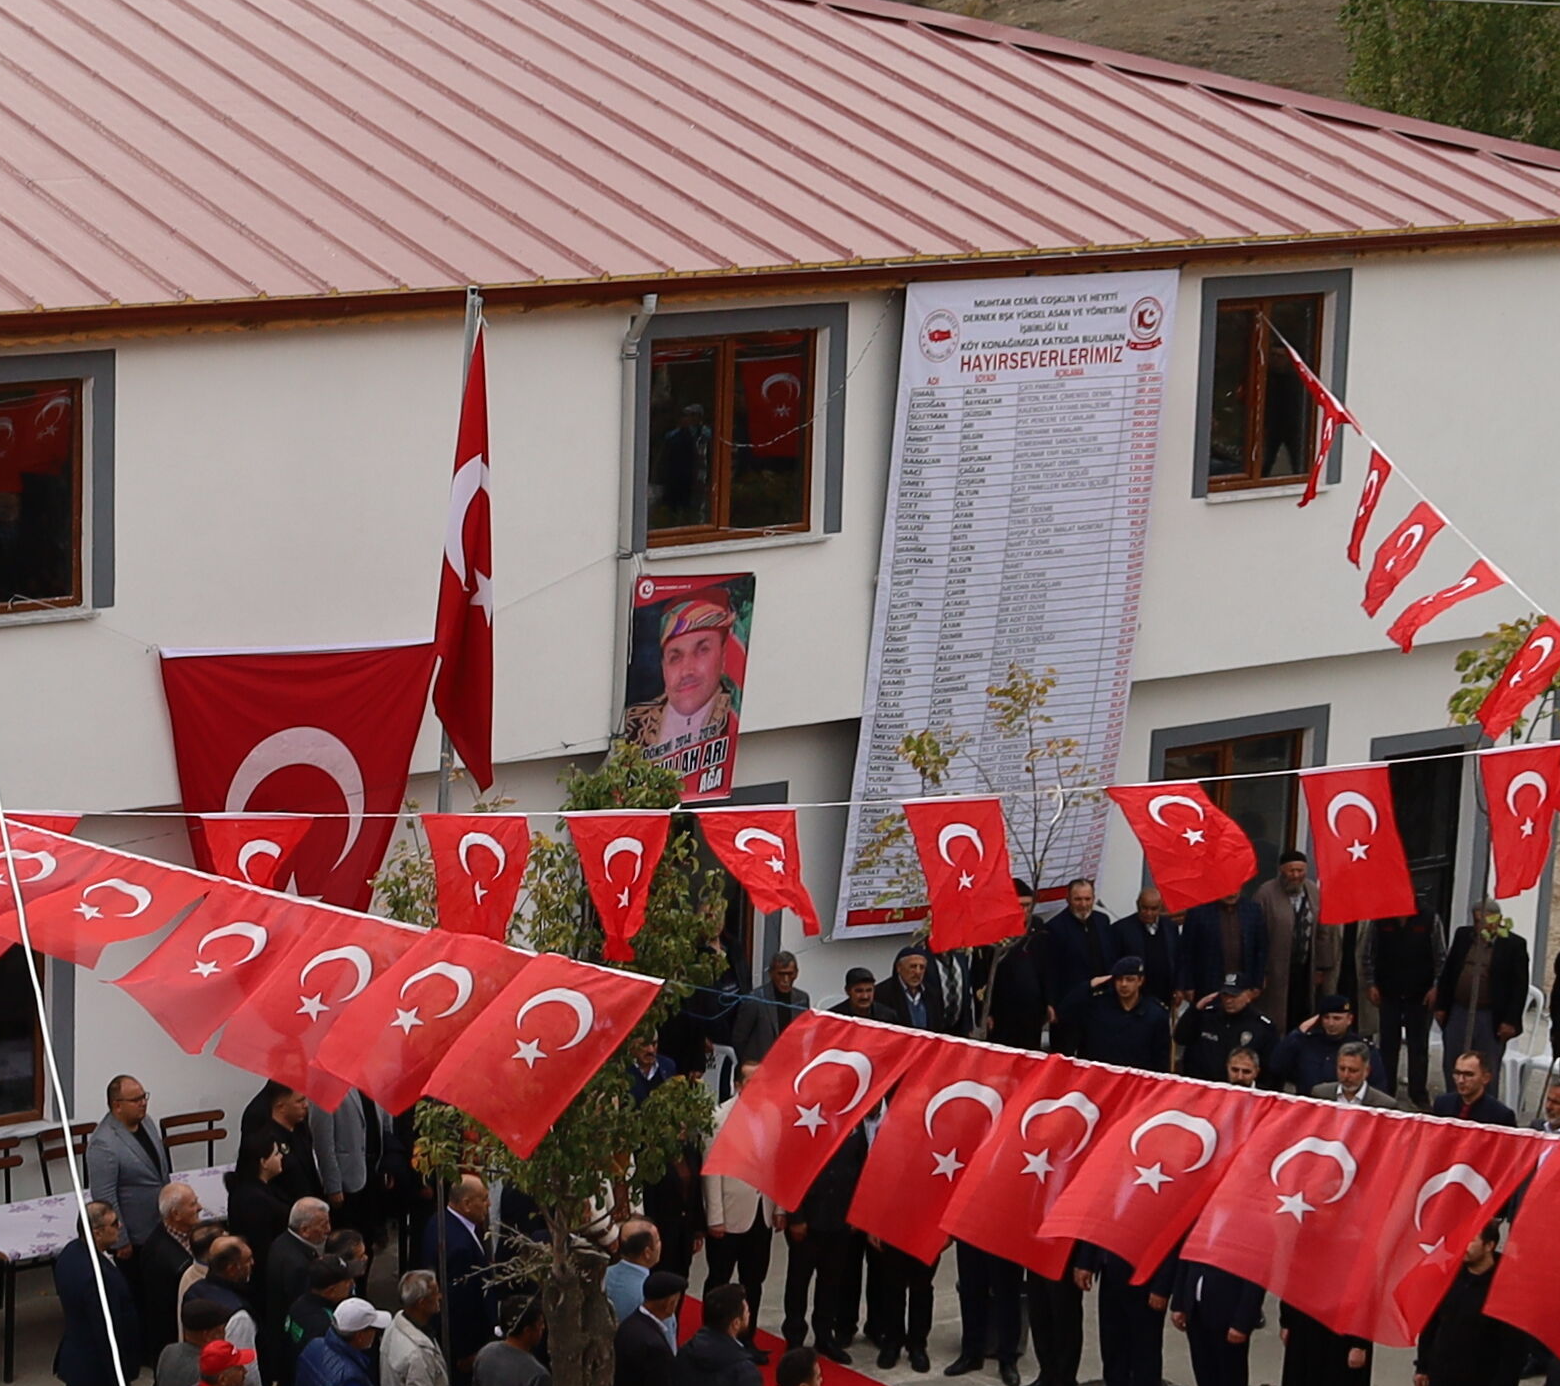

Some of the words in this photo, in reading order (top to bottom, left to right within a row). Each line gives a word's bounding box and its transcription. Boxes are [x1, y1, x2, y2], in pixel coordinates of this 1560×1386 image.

[974, 298, 1011, 308] MUHTAR
[1013, 296, 1038, 306] CEMİL
[1041, 295, 1075, 305] COŞKUN
[1077, 294, 1087, 302] VE
[1090, 292, 1118, 302] HEYETİ
[963, 313, 997, 323] DERNEK
[1017, 310, 1045, 319] YÜKSEL
[1048, 309, 1070, 318] ASAN
[1073, 308, 1083, 316] VE
[1086, 305, 1127, 315] YÖNETİMİ
[961, 340, 979, 351] KÖY
[981, 338, 1039, 350] KONAĞIMIZA
[1041, 335, 1079, 345] KATKIDA
[1082, 333, 1125, 343] BULUNAN
[960, 344, 1123, 373] HAYIRSEVERLERİMİZ
[702, 737, 728, 768] ARI
[699, 766, 723, 793] AĞA
